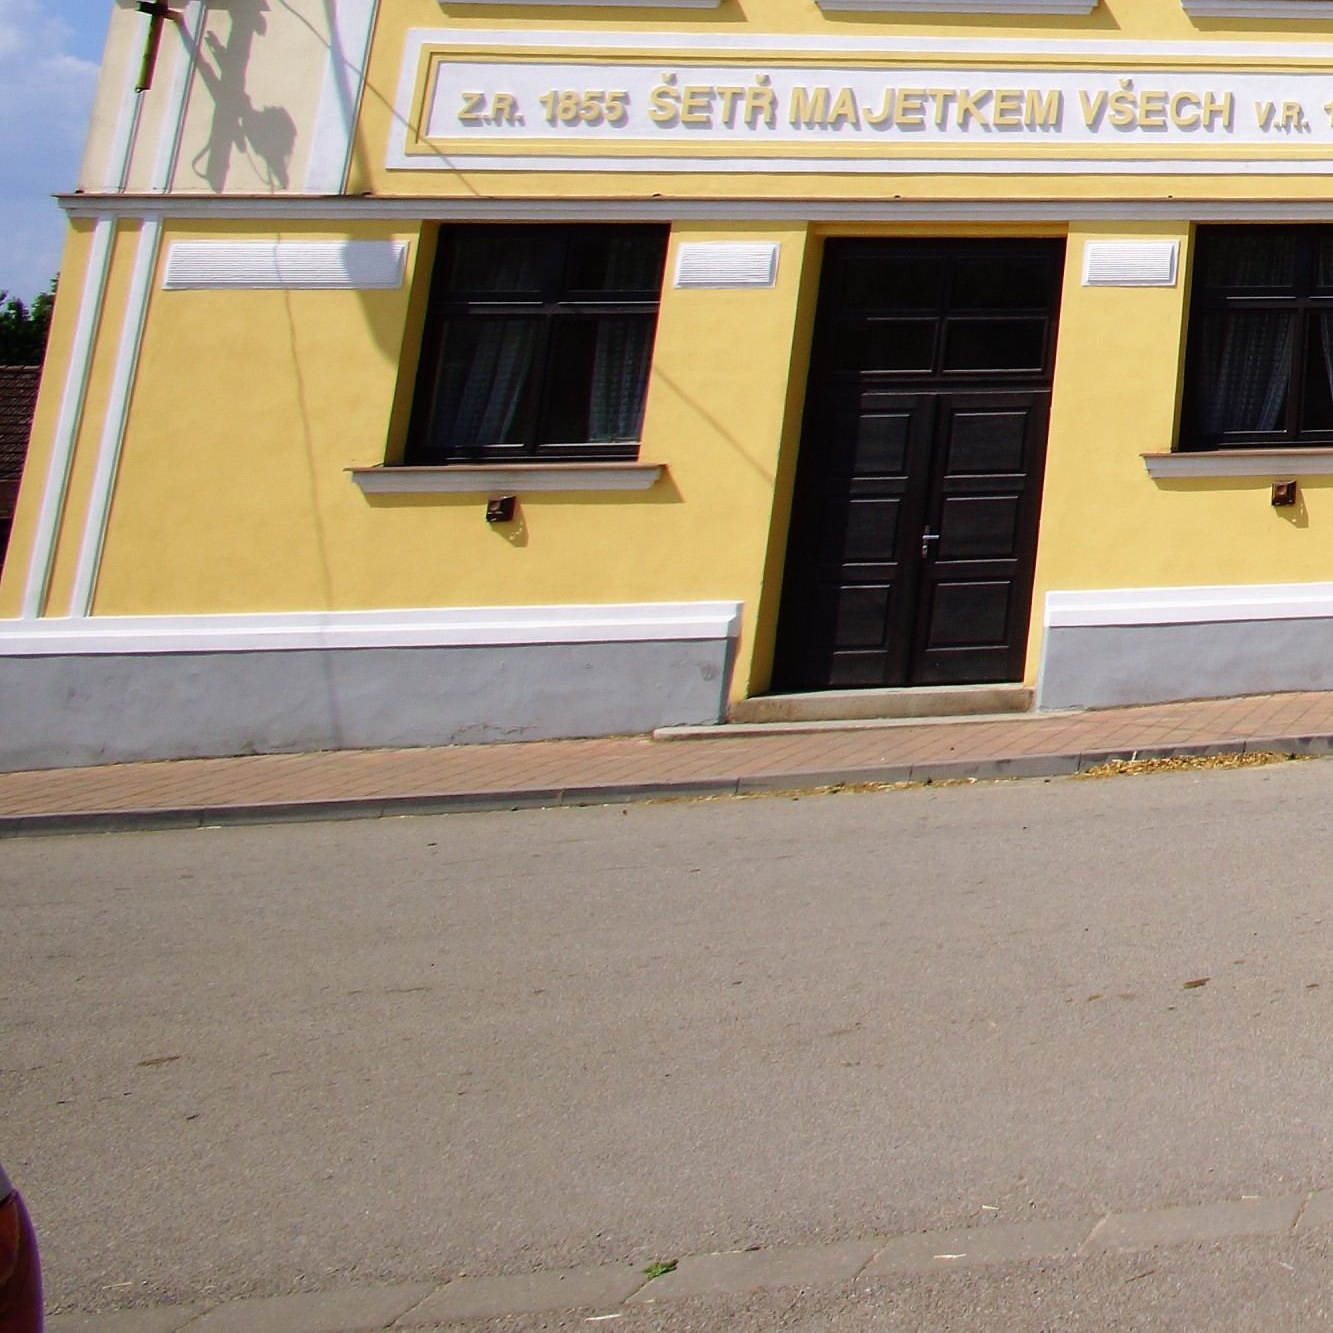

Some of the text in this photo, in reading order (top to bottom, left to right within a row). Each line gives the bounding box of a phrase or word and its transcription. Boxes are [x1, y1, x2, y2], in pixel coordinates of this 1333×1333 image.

[458, 91, 524, 121] Z.R.
[539, 89, 627, 122] 1855
[648, 72, 775, 124] ŠETŘ
[788, 86, 1062, 126] MAJETKEM
[1078, 78, 1233, 128] VŠECH
[1255, 100, 1309, 129] V.R.
